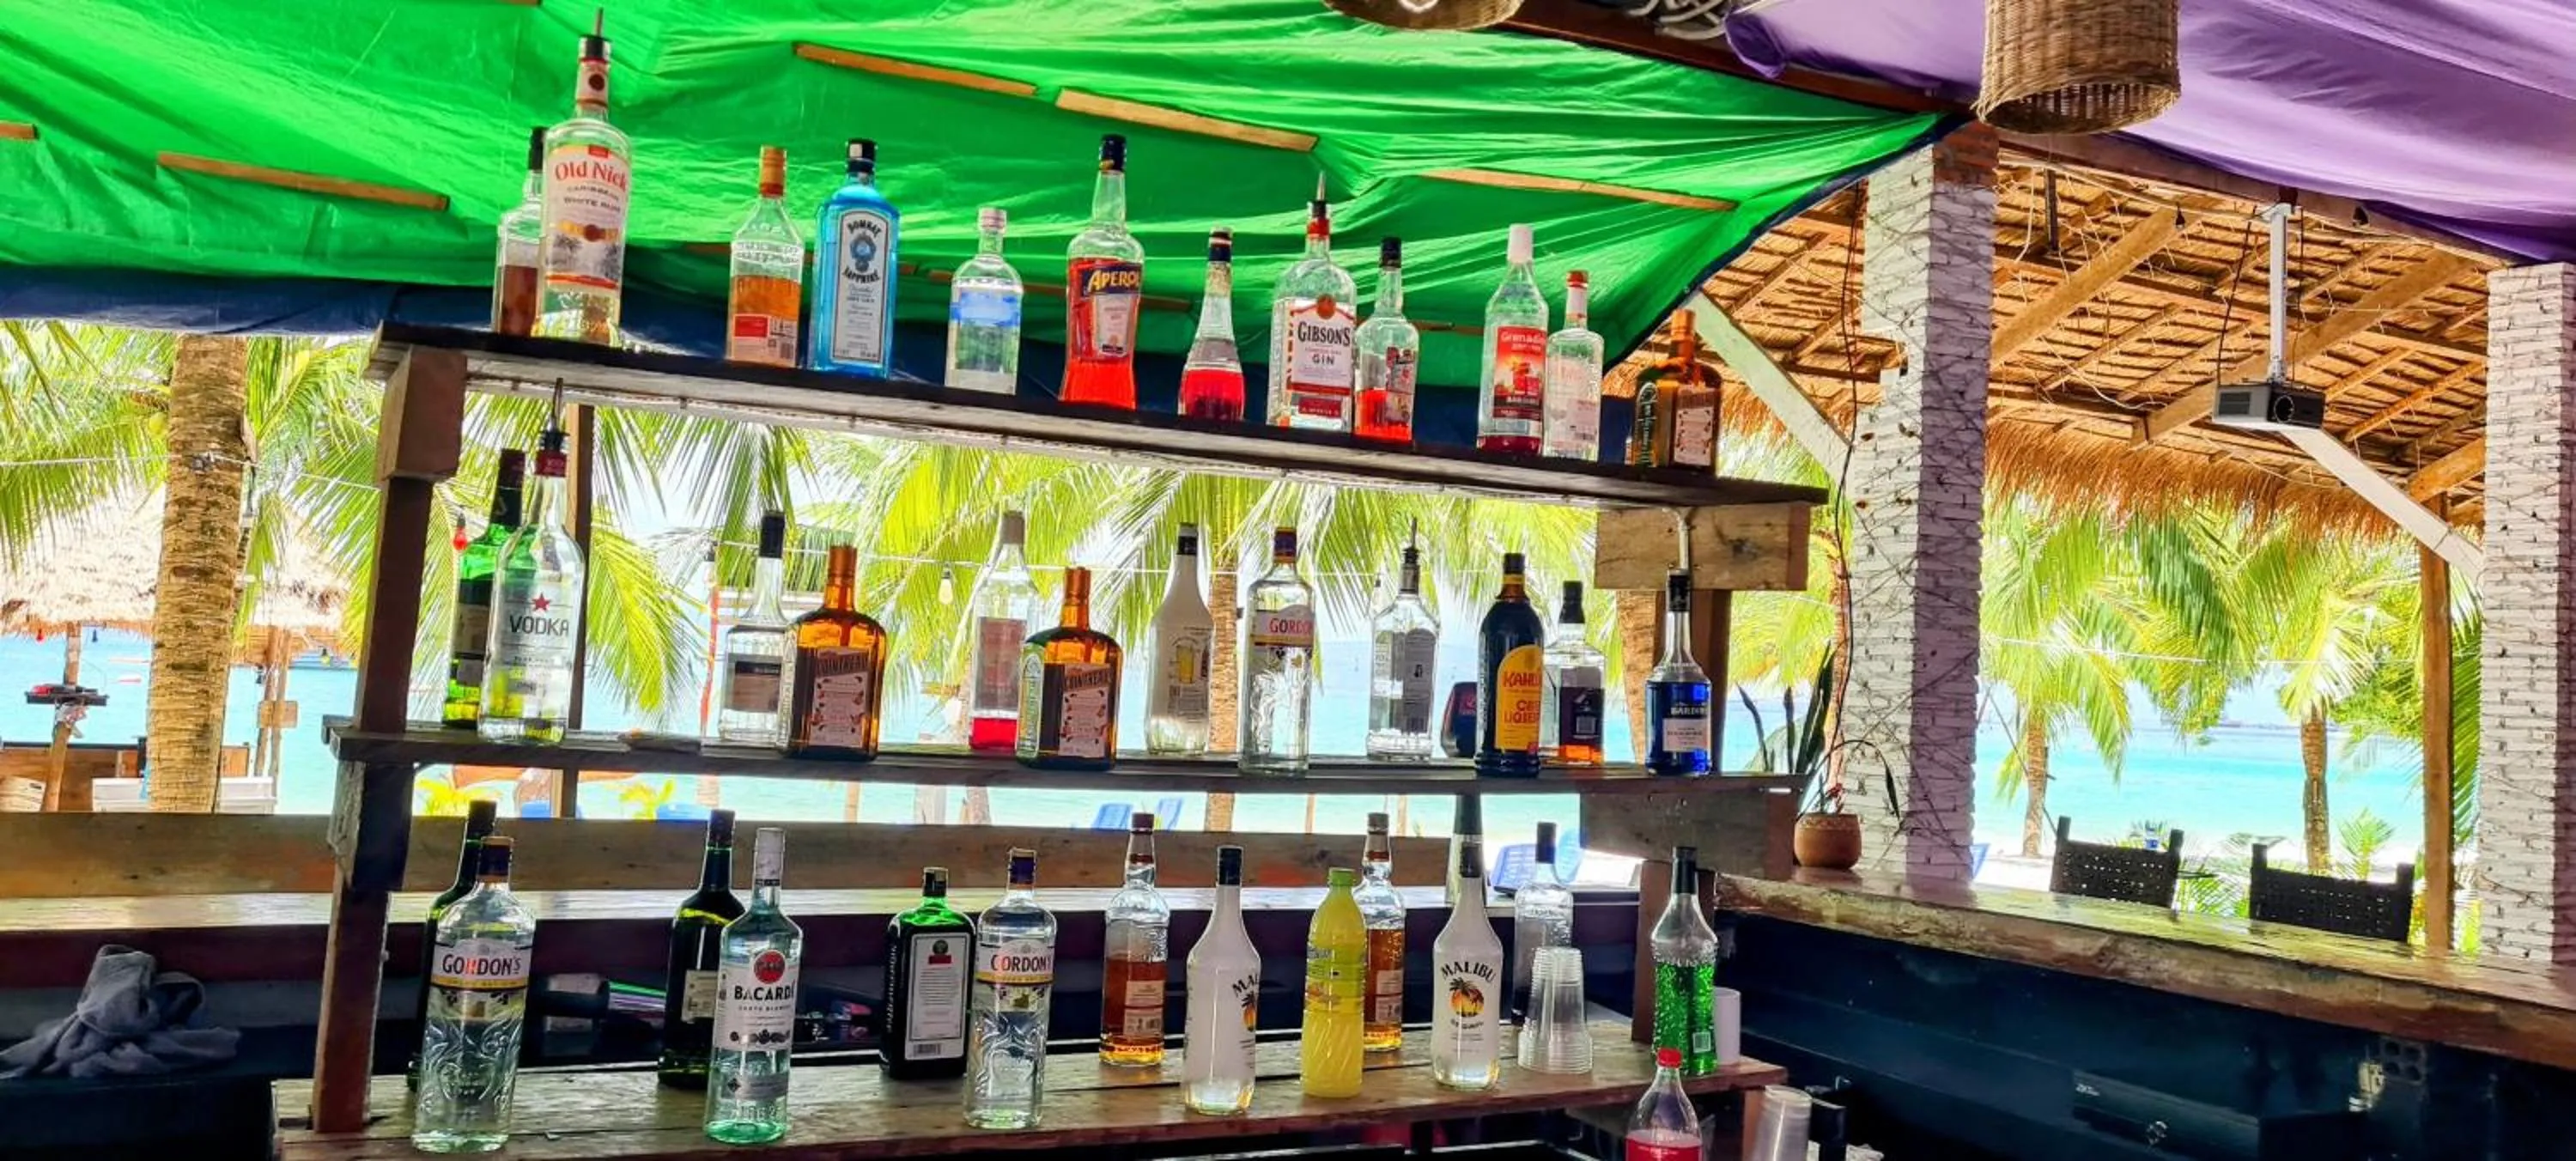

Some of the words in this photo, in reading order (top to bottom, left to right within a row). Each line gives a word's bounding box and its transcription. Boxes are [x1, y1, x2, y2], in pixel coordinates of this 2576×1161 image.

[555, 161, 587, 181] Old
[847, 219, 883, 238] BOMBAY
[1311, 353, 1335, 365] GIN
[509, 615, 570, 637] VODKA
[1440, 960, 1497, 984] MALIBU
